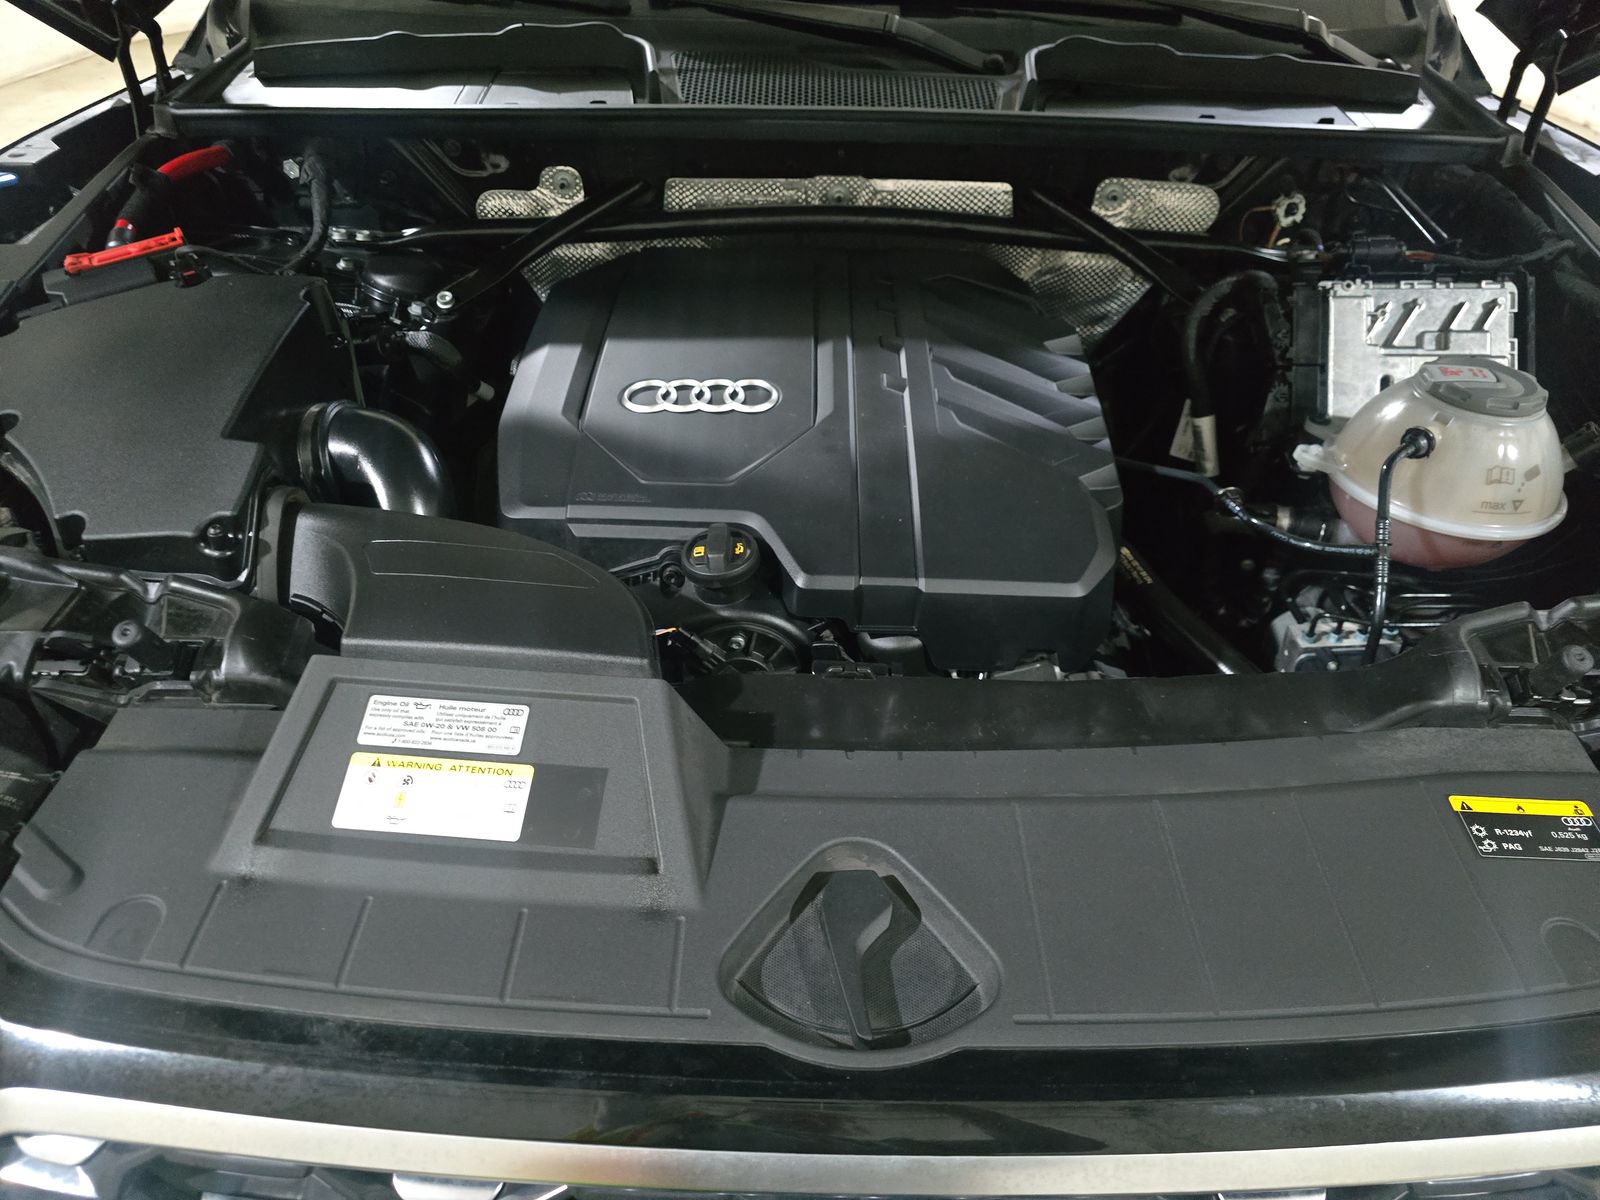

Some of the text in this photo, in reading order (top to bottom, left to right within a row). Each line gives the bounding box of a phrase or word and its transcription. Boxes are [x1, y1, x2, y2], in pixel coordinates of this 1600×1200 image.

[1480, 501, 1506, 510] max
[386, 760, 513, 776] WARNING ATTENTION
[1494, 828, 1533, 838] R-1234yf
[1576, 832, 1589, 840] kg
[1502, 842, 1523, 851] PAG
